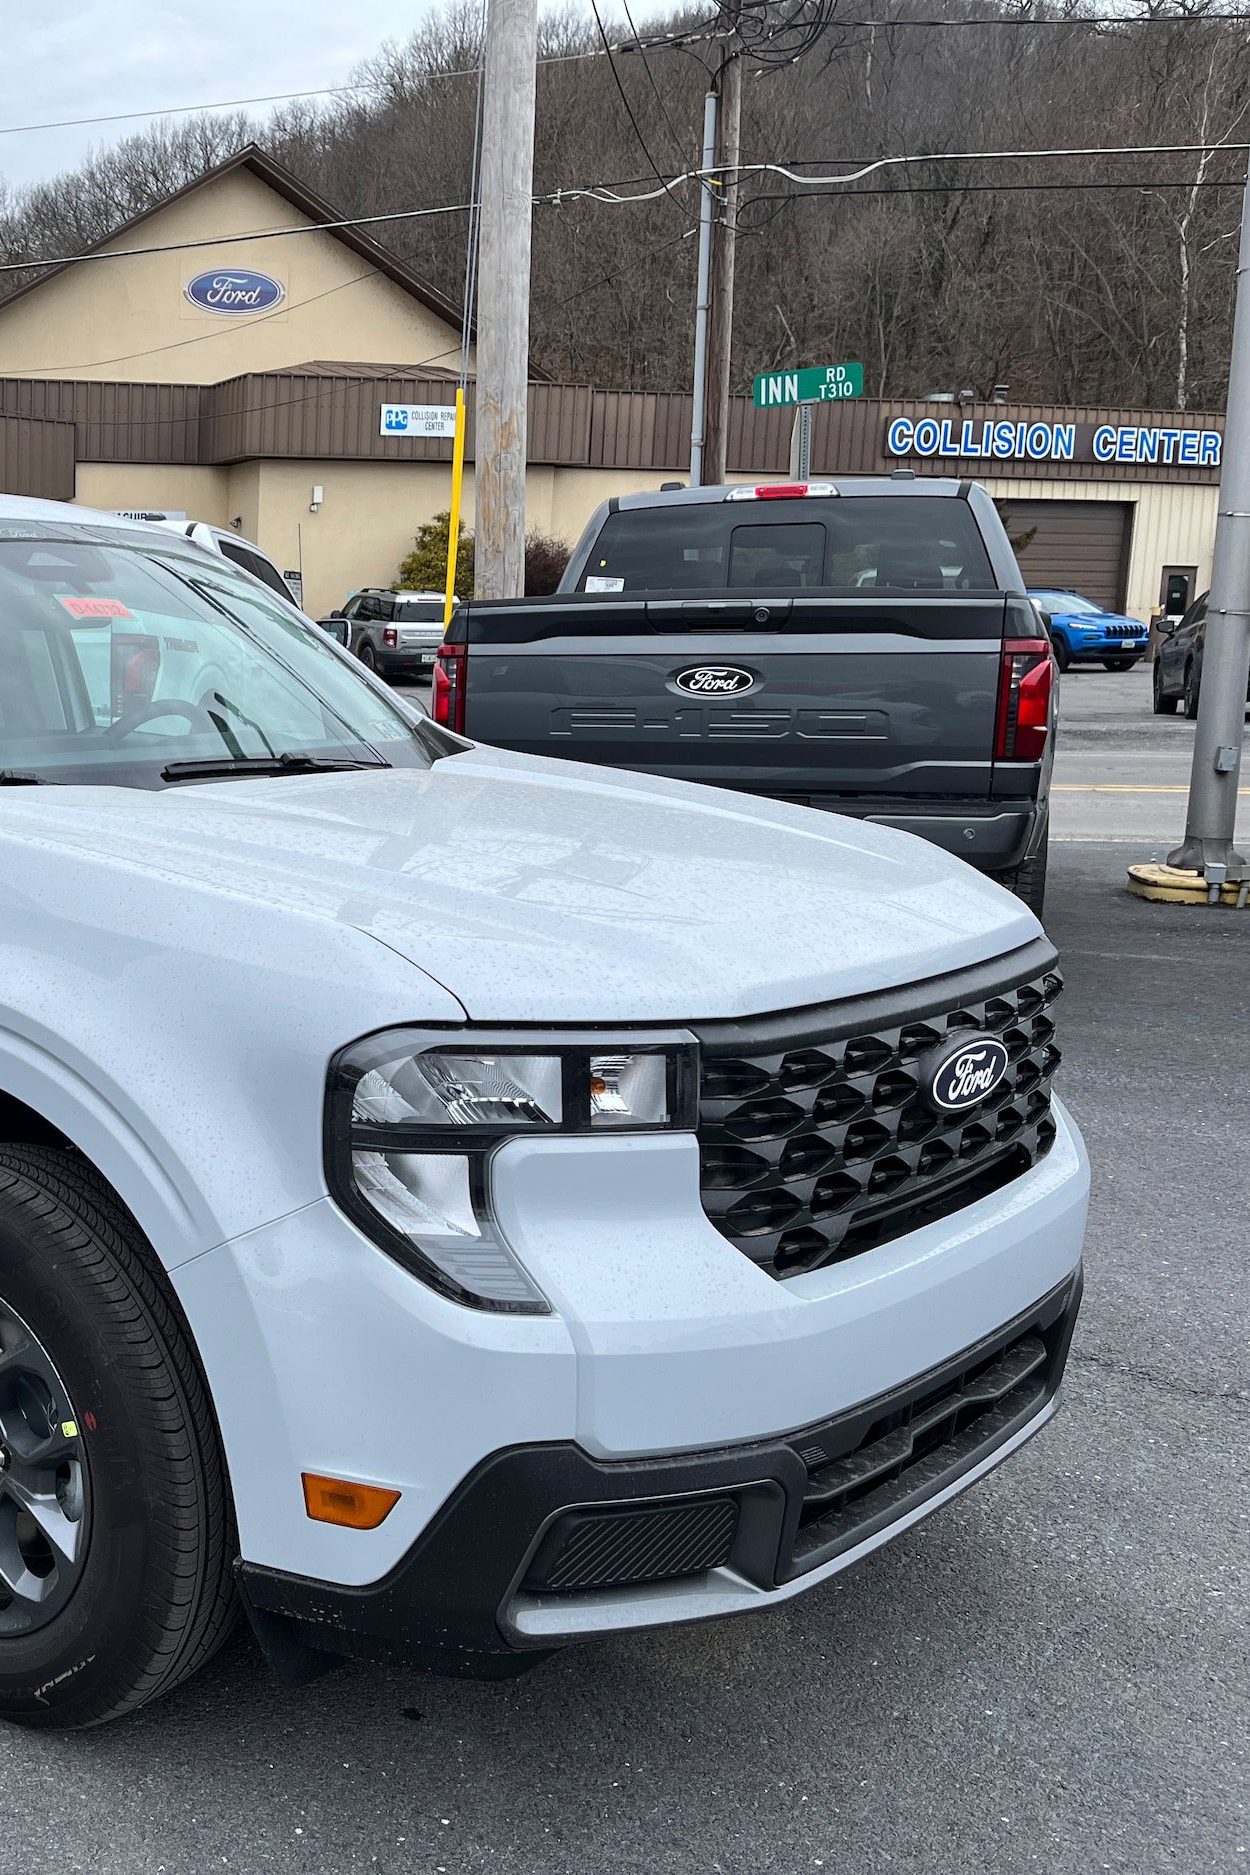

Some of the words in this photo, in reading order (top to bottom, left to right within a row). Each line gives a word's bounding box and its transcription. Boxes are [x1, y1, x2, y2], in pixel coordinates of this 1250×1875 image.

[207, 276, 261, 304] Ford
[826, 366, 846, 382] RD
[760, 374, 798, 405] INN
[819, 381, 853, 399] T310
[386, 410, 408, 427] PPG
[411, 410, 438, 421] COLLISION
[424, 421, 445, 431] CENTER
[888, 417, 1076, 460] COLLISION
[1093, 425, 1222, 465] CENTER
[688, 669, 739, 691] Ford
[550, 706, 889, 739] F-150
[948, 1050, 997, 1101] Ford
